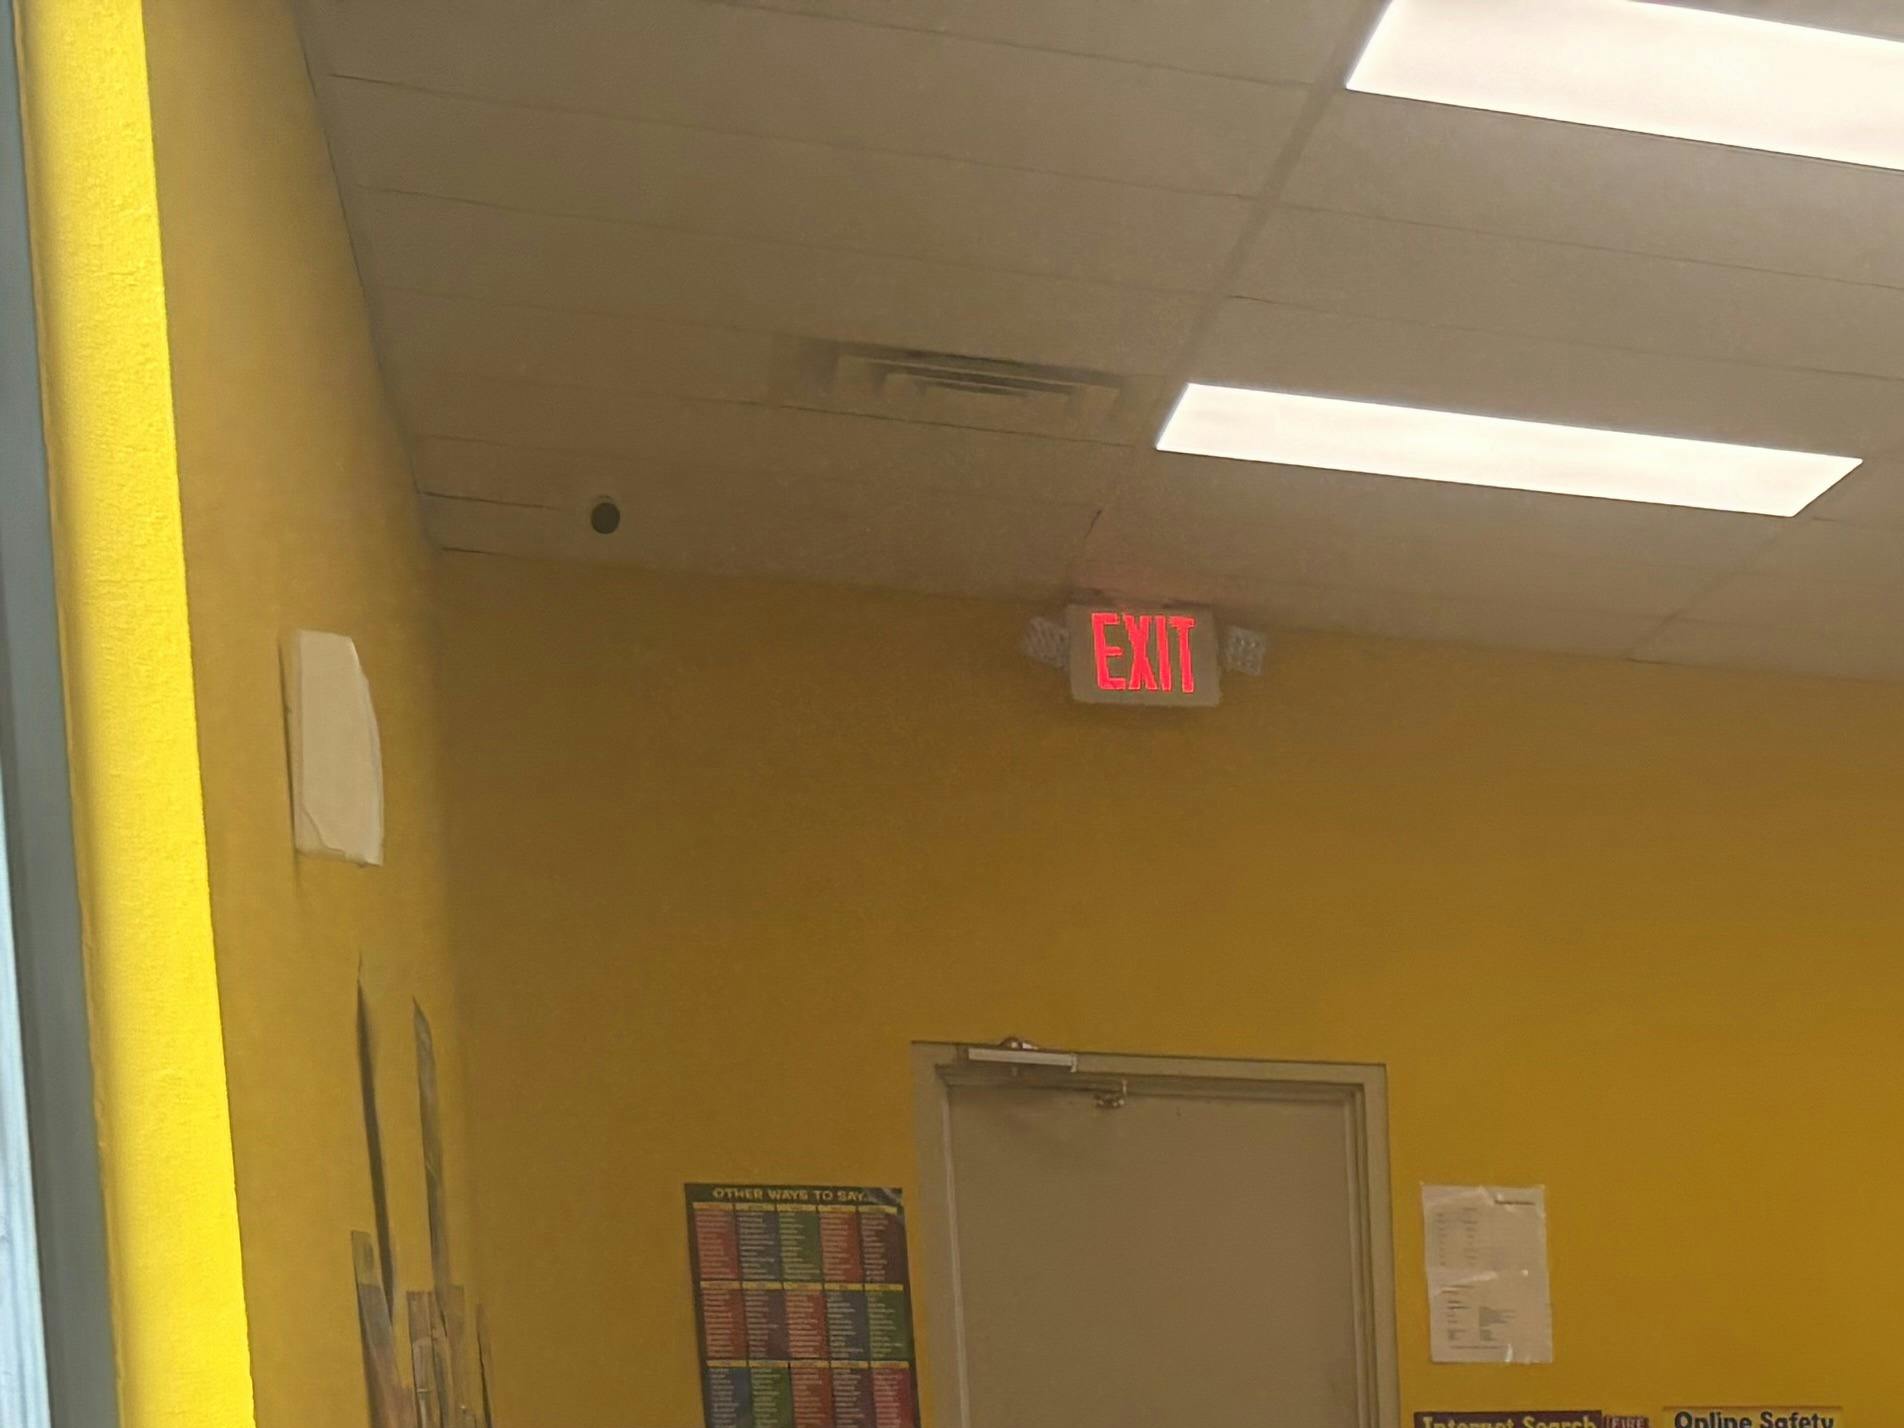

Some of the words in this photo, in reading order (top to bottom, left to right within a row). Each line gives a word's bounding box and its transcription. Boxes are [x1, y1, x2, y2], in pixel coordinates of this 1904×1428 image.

[1091, 612, 1196, 693] EXIT
[713, 1187, 763, 1199] OTHER
[768, 1188, 808, 1200] WAYS
[815, 1190, 834, 1201] TO
